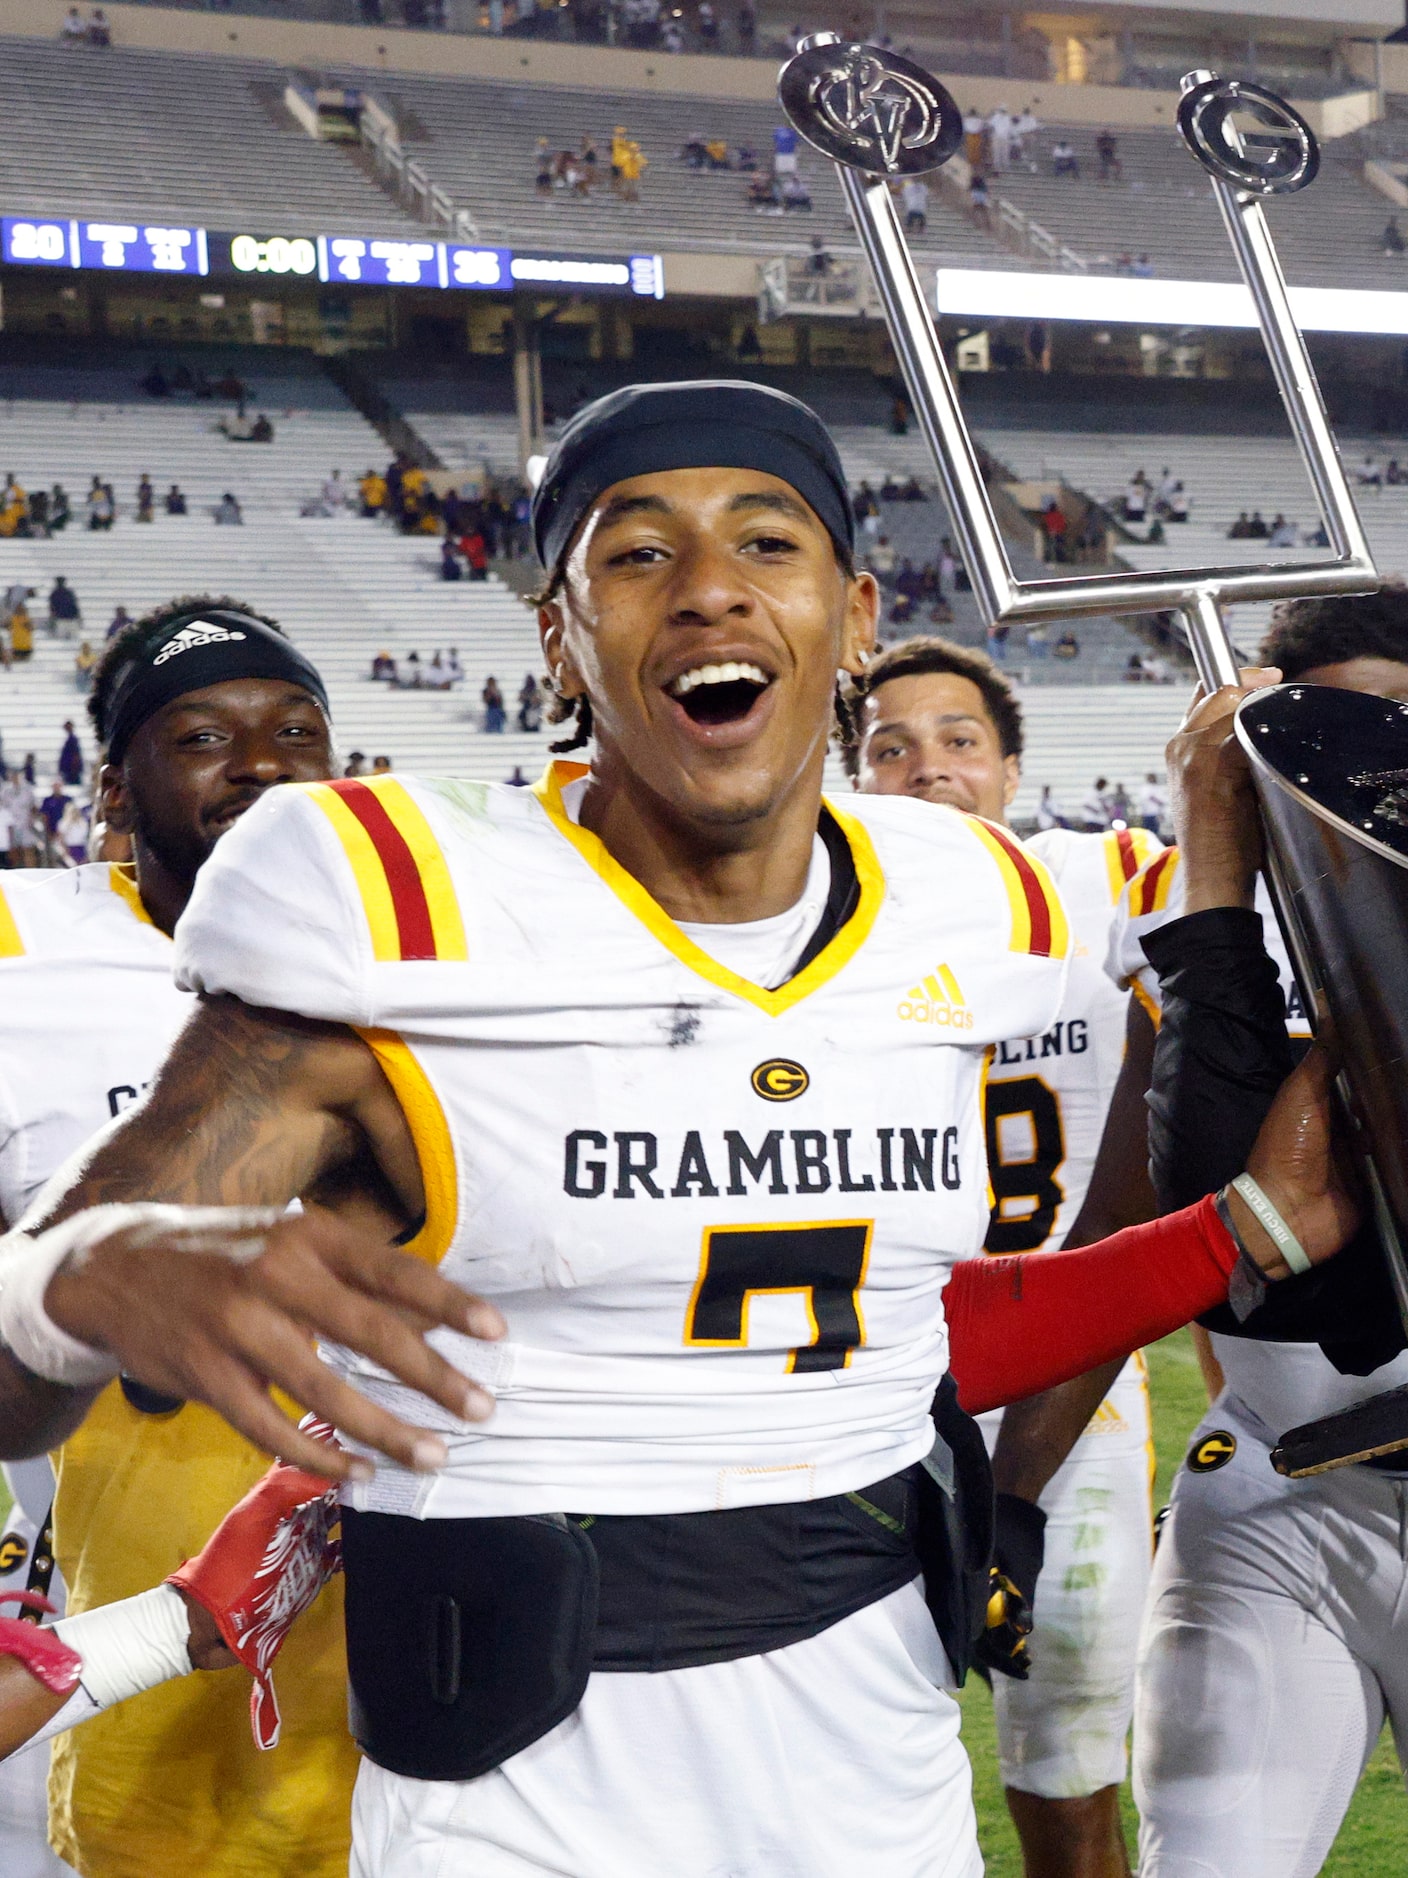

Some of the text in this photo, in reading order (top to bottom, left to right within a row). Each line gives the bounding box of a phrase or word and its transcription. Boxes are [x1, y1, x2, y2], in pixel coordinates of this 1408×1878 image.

[231, 235, 316, 275] 0:00
[153, 631, 248, 666] adidas
[897, 1001, 974, 1030] adidas
[563, 1126, 961, 1200] GRAMBLING
[1262, 1212, 1291, 1244] HBCU
